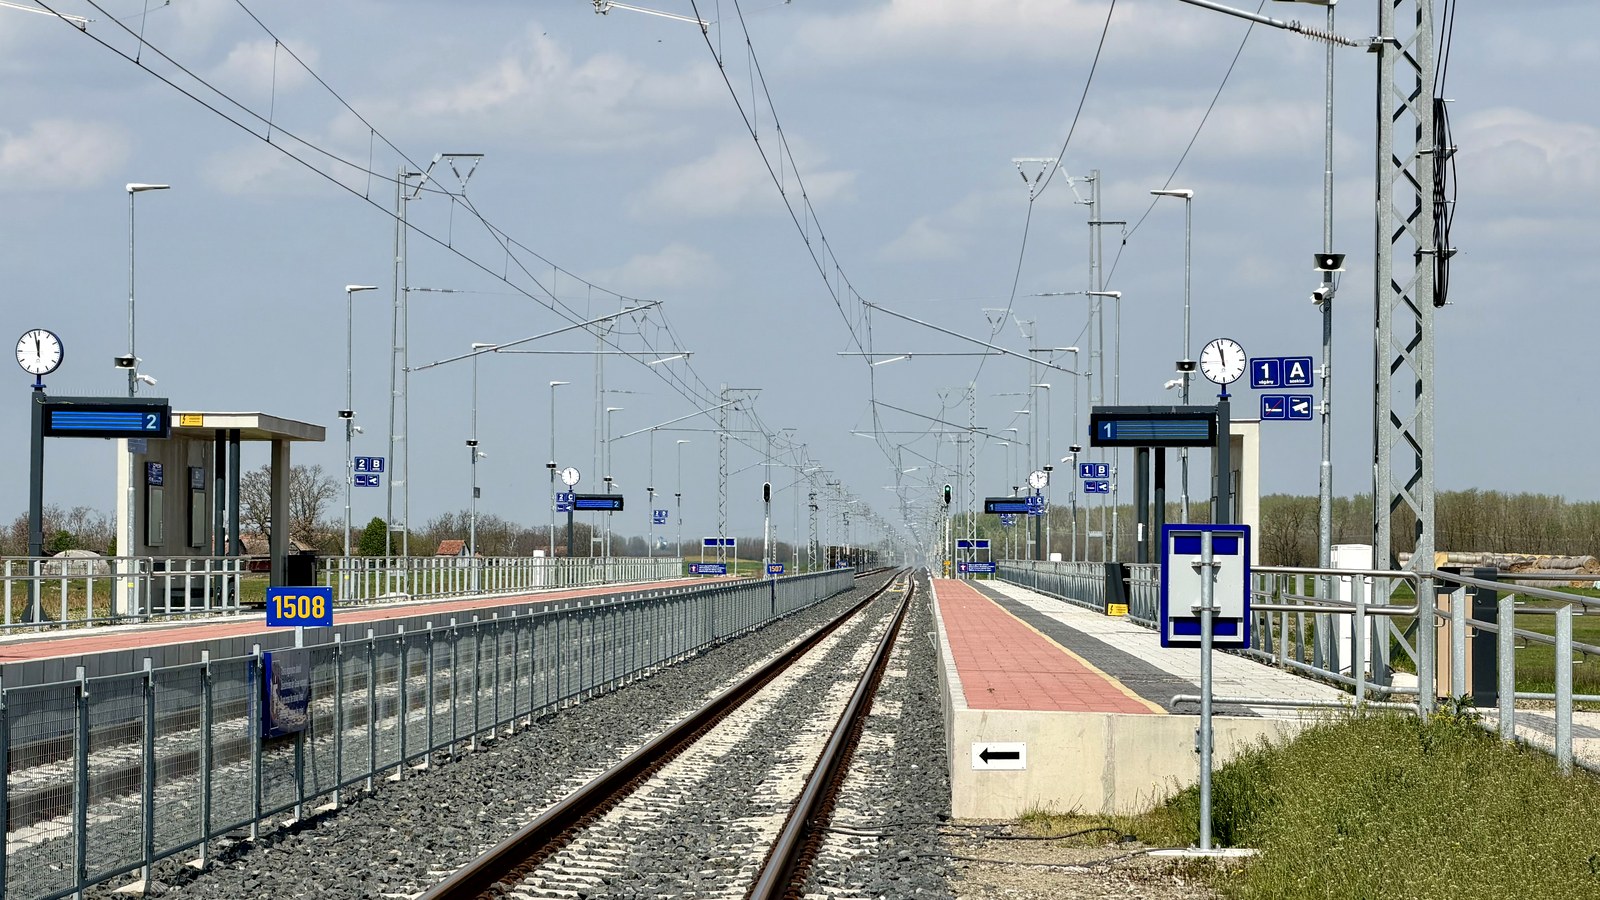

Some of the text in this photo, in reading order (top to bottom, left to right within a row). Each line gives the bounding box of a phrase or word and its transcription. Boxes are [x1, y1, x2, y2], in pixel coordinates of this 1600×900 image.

[1261, 362, 1305, 379] 1 A
[146, 414, 157, 429] 2
[1103, 422, 1111, 438] 1
[359, 459, 380, 468] 2 B
[1084, 465, 1105, 474] 1 B
[614, 500, 619, 508] 2
[990, 503, 994, 511] 1
[272, 595, 325, 619] 1508
